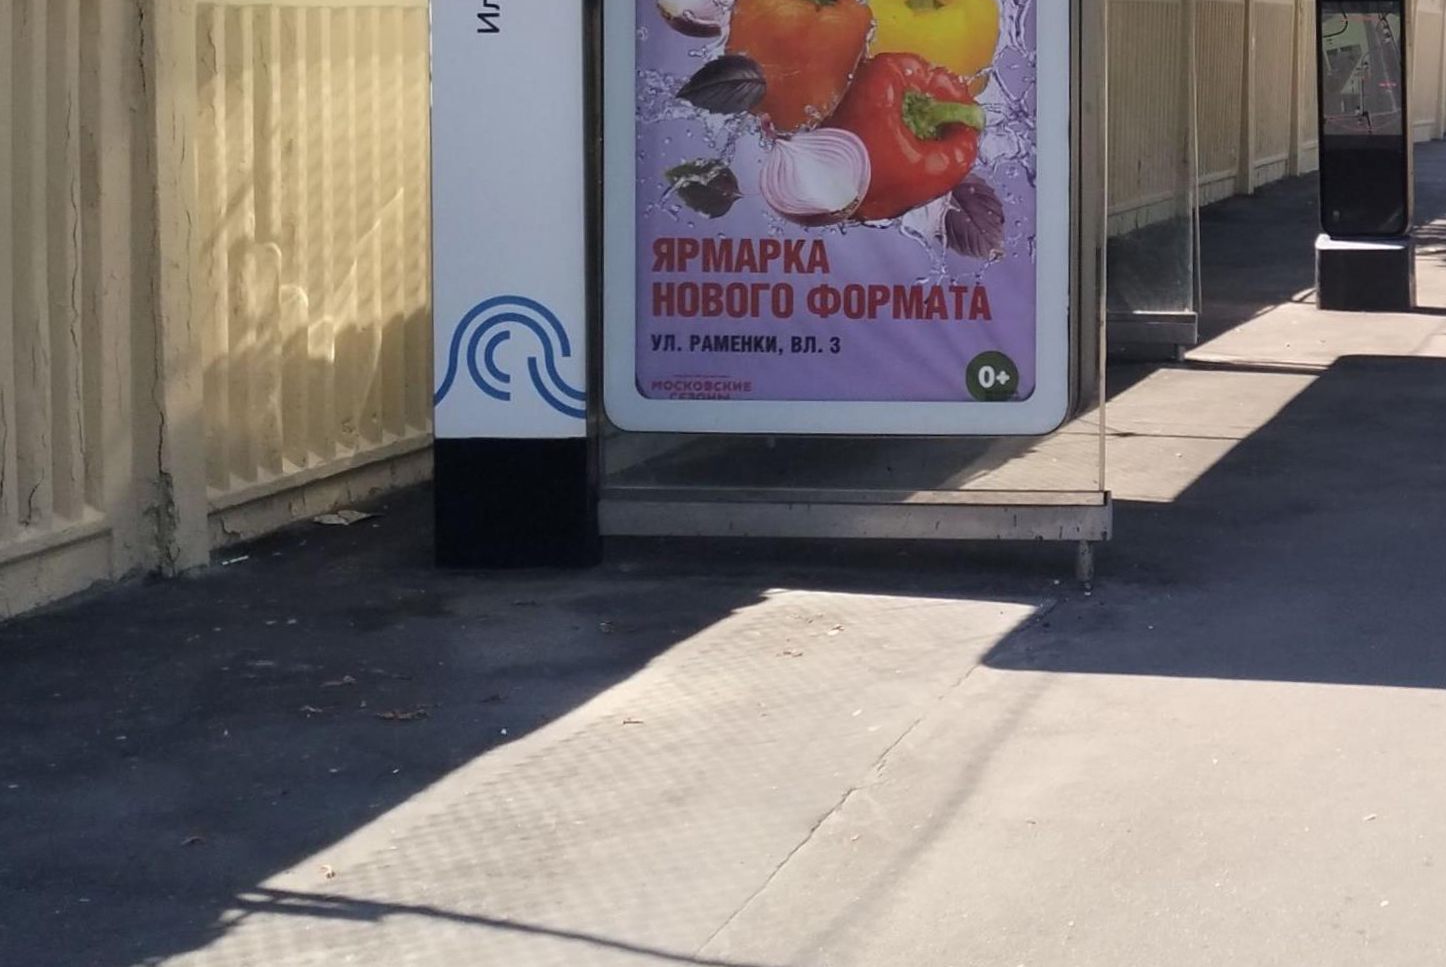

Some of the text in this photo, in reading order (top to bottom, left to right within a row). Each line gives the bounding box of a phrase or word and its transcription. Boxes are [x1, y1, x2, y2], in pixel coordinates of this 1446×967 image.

[651, 237, 831, 275] ЯРМАРКА
[651, 282, 993, 321] НОВОГО ФОРМАТА
[651, 334, 842, 356] УЛ. РАМЕНКИ, ВЛ. 3
[650, 380, 754, 392] МОСКОВСКИЕ
[978, 365, 1011, 389] 0+
